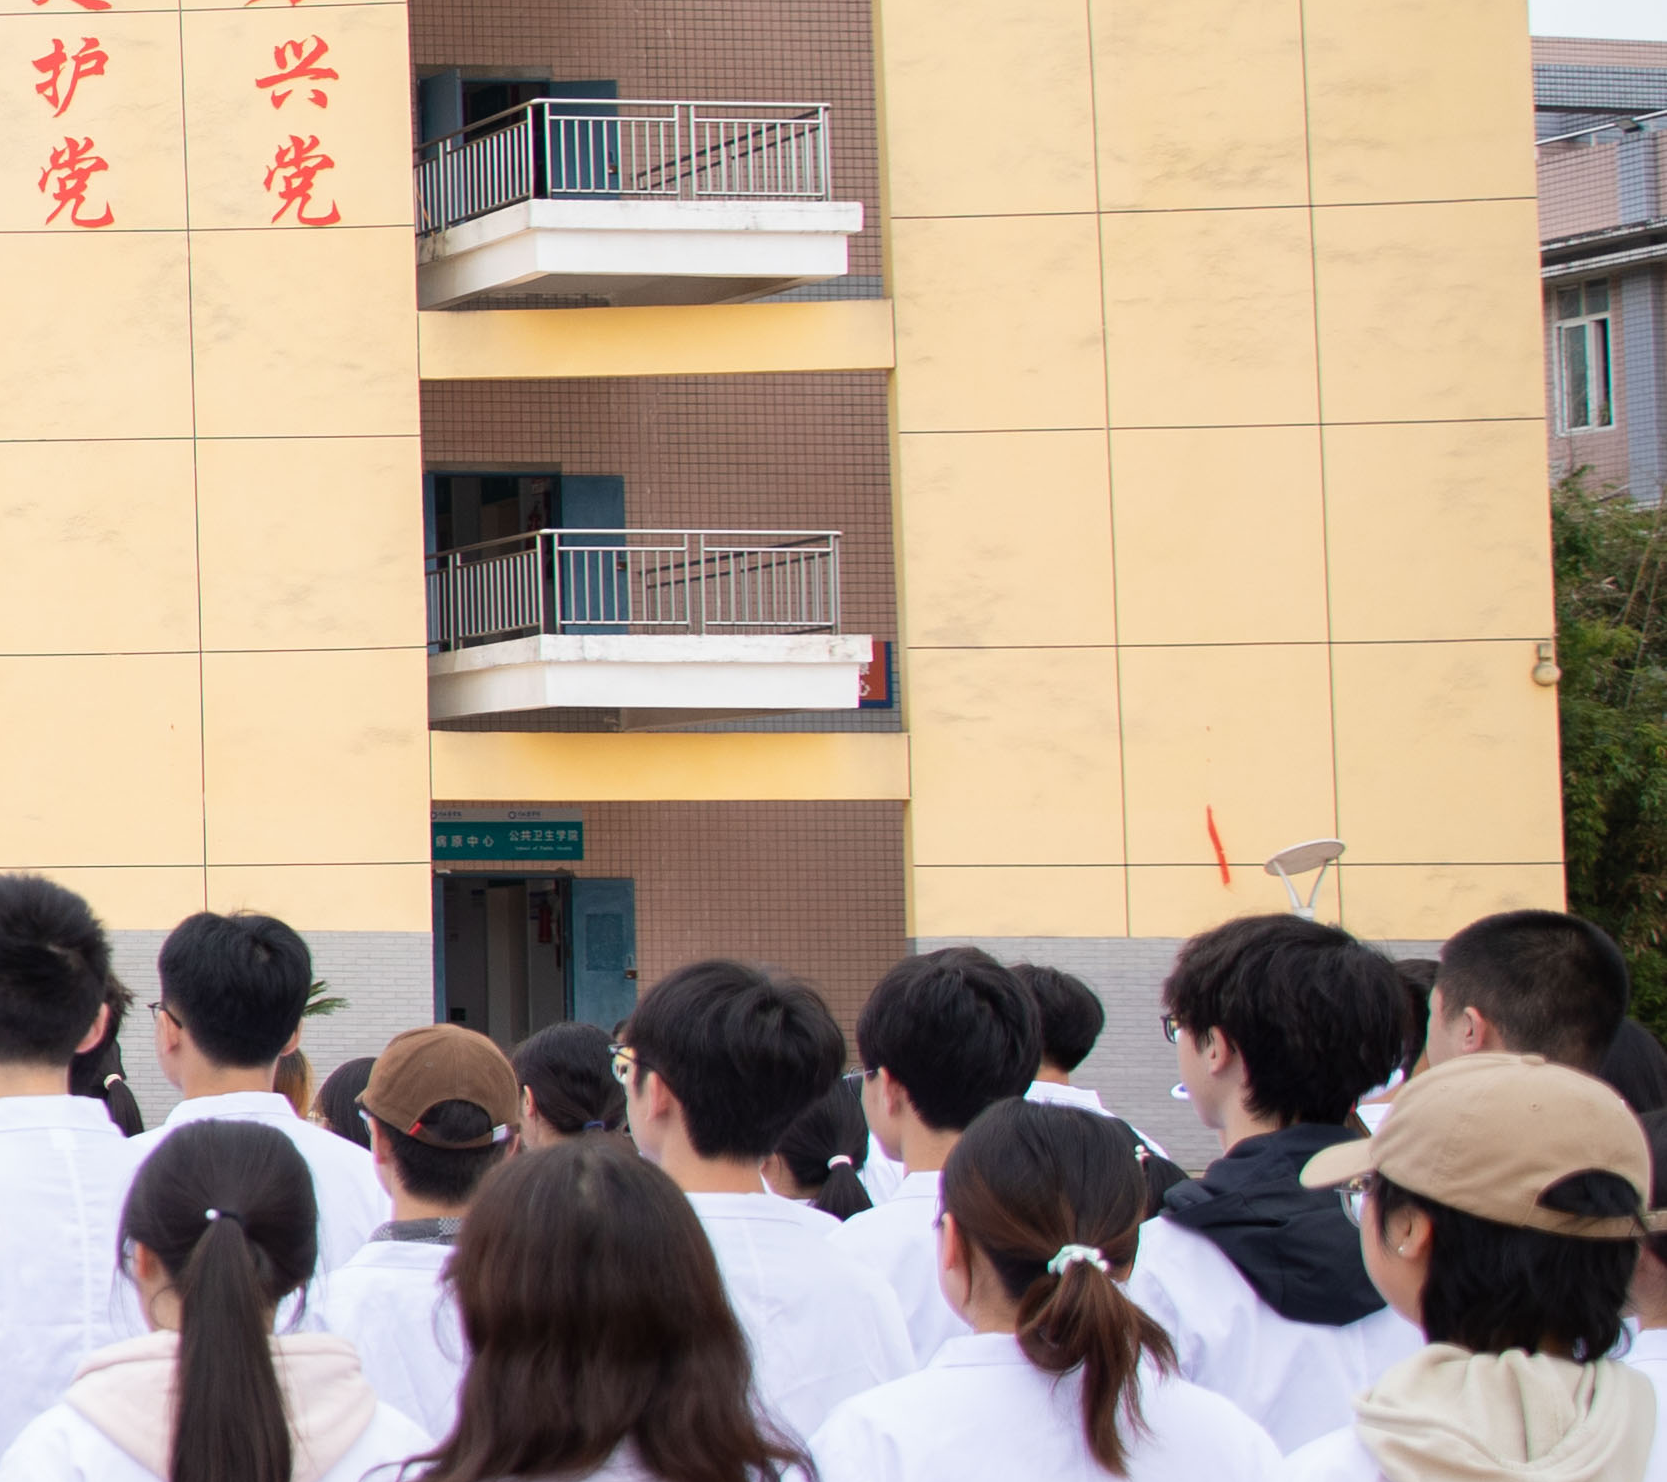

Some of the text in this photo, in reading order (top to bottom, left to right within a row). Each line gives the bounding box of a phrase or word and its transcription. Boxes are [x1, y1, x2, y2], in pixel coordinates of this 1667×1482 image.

[509, 829, 579, 842] 公共卫生学院
